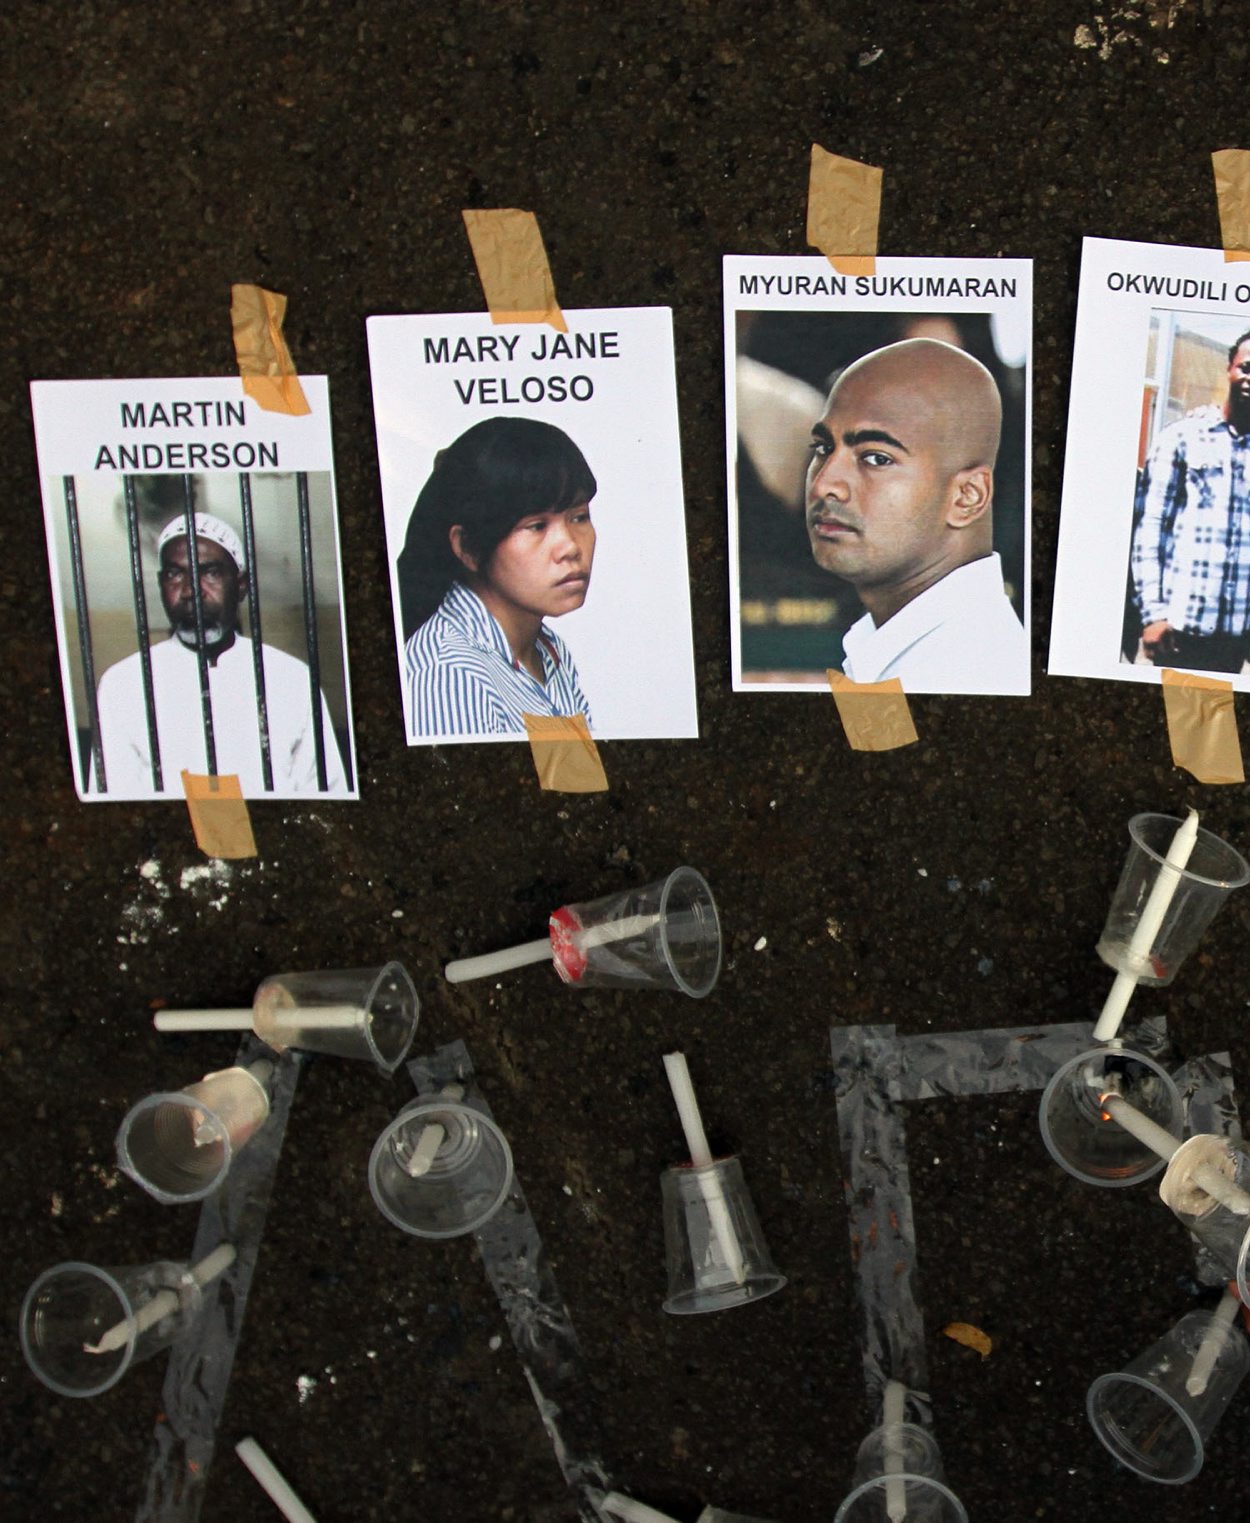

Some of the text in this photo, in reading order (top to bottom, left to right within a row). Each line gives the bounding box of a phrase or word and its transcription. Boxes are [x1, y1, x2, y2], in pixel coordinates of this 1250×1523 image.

[739, 274, 1017, 298] MYURAN SUKUMARAN
[1107, 271, 1227, 301] OKWUDILI
[423, 331, 620, 364] MARY JANE
[454, 375, 594, 405] VELOSO
[121, 401, 246, 428] MARTIN
[94, 441, 279, 469] ANDERSON
